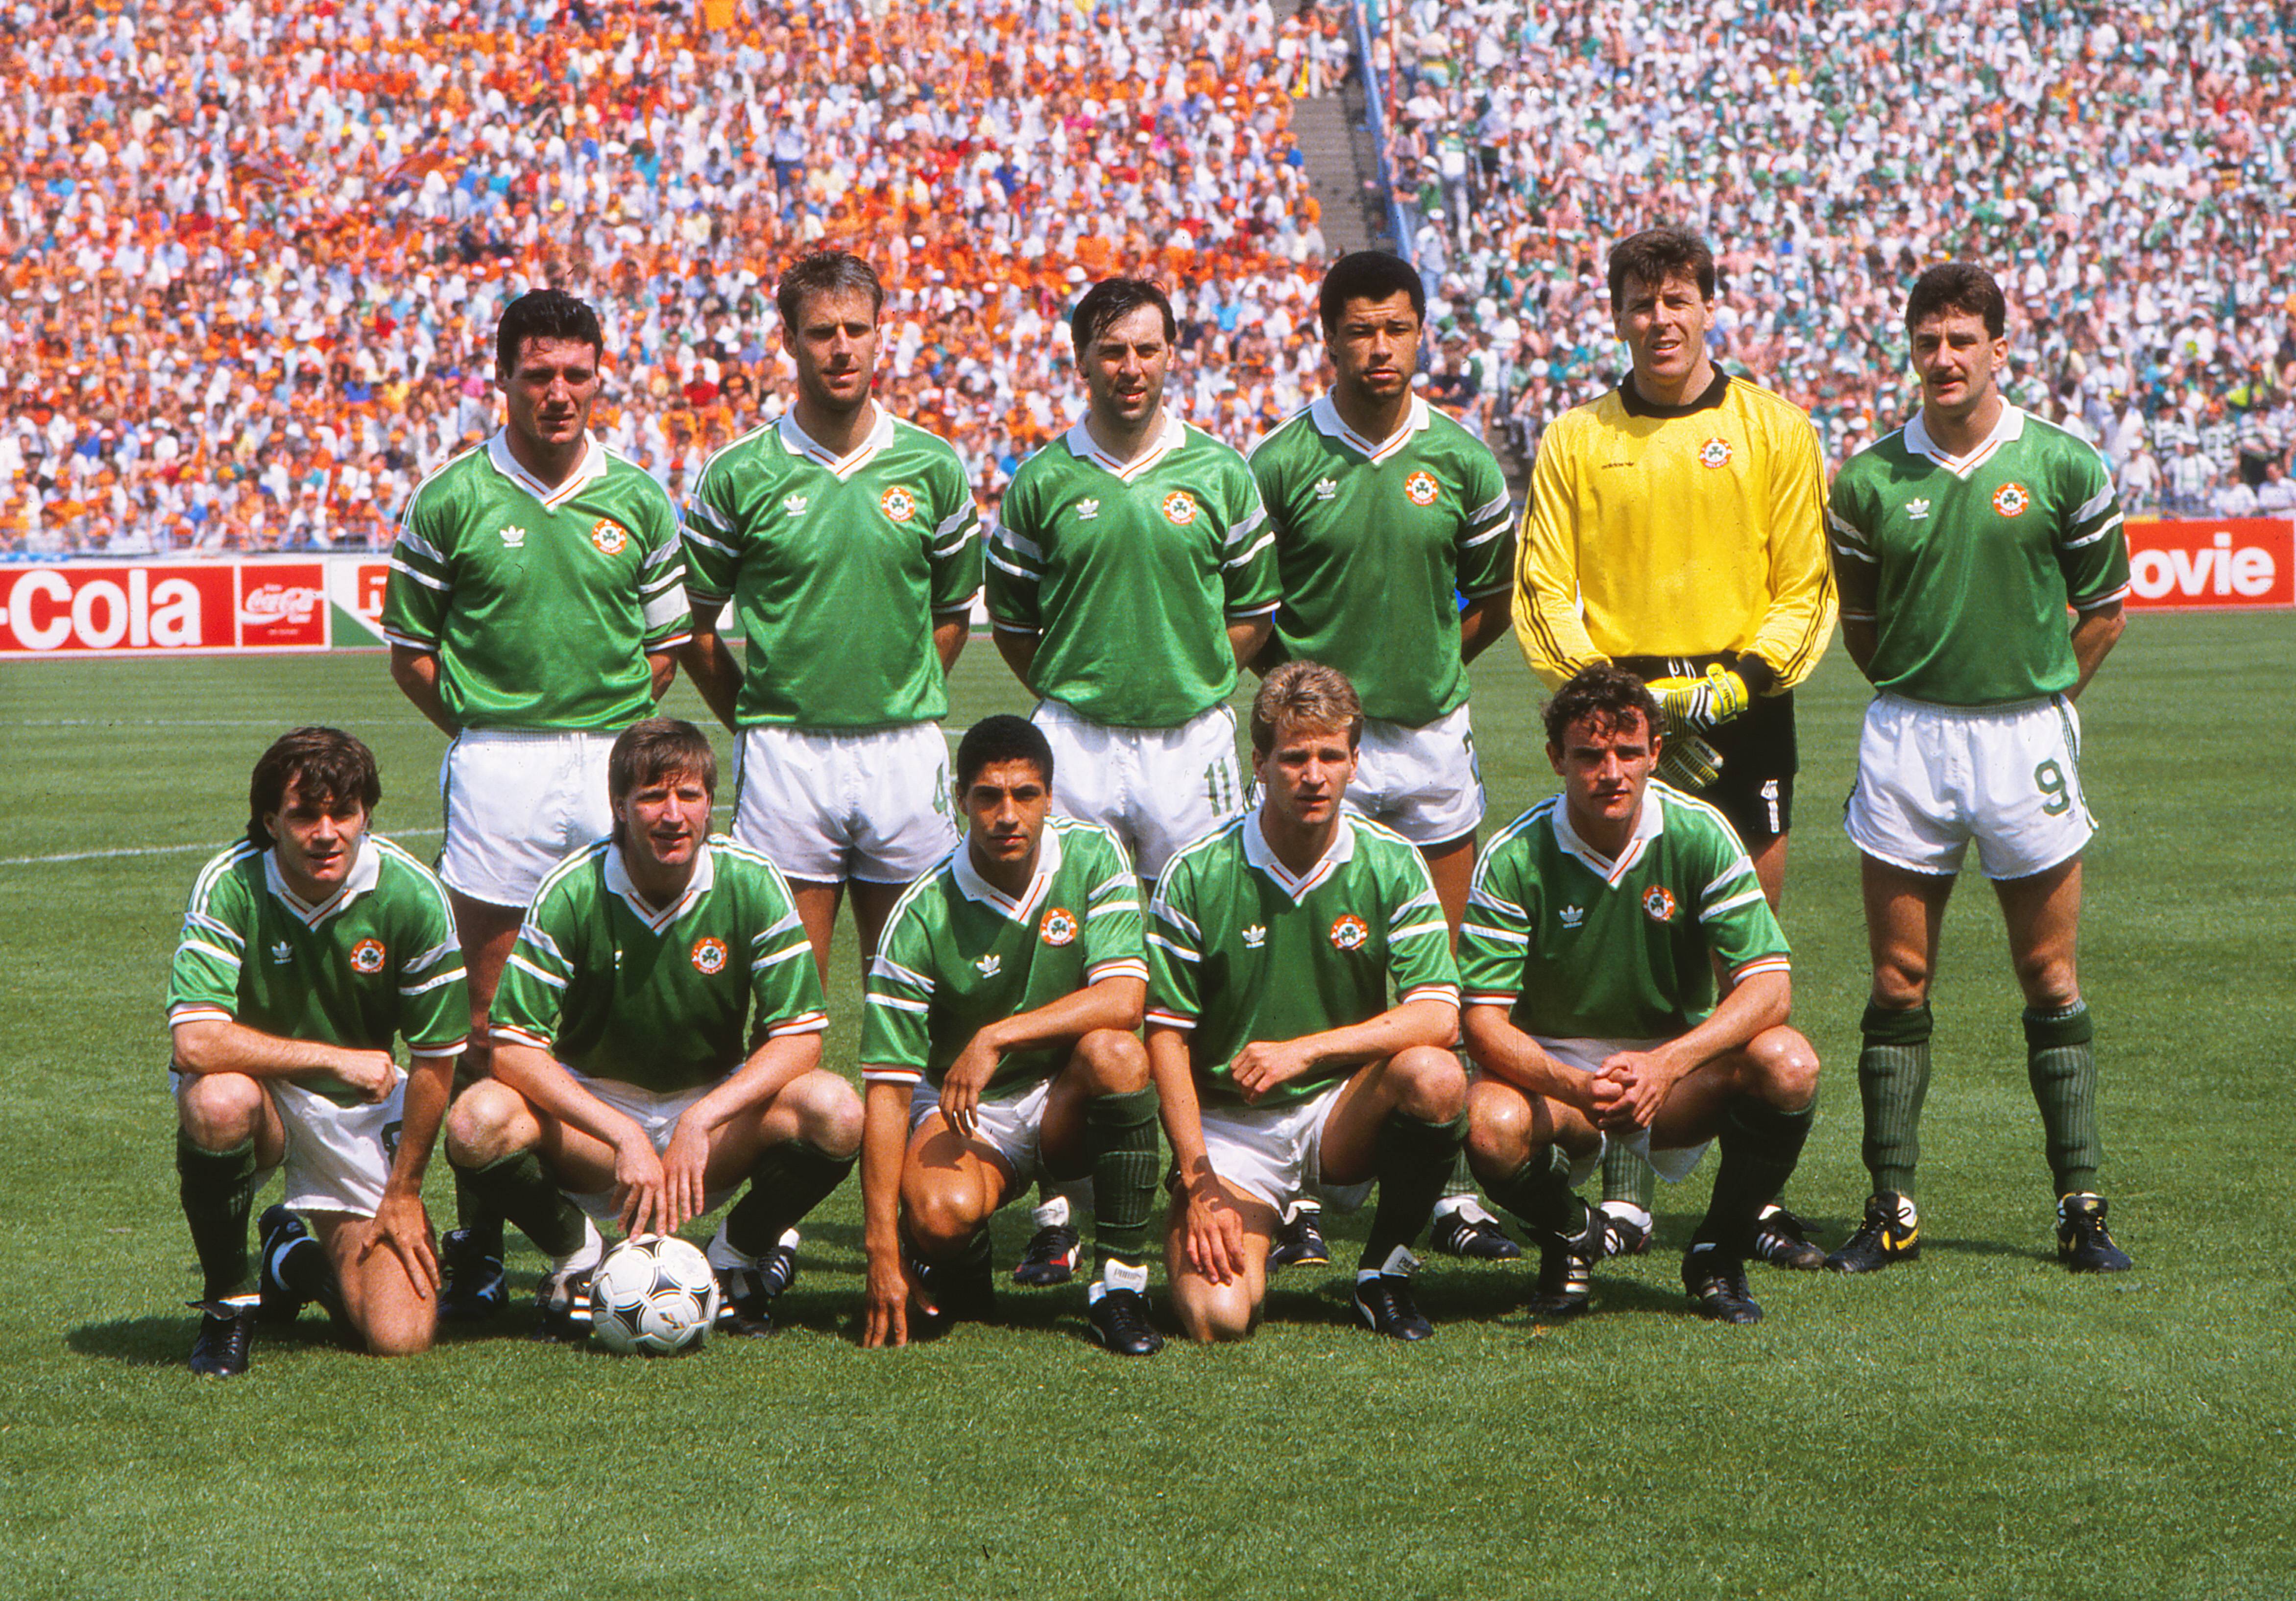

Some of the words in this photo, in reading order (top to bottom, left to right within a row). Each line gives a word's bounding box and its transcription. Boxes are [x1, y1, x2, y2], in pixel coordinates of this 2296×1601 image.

[2126, 532, 2275, 599] ovie
[0, 569, 202, 650] Cola
[1204, 757, 1233, 817] 11
[1761, 779, 1780, 833] 1
[2034, 758, 2071, 817] 9
